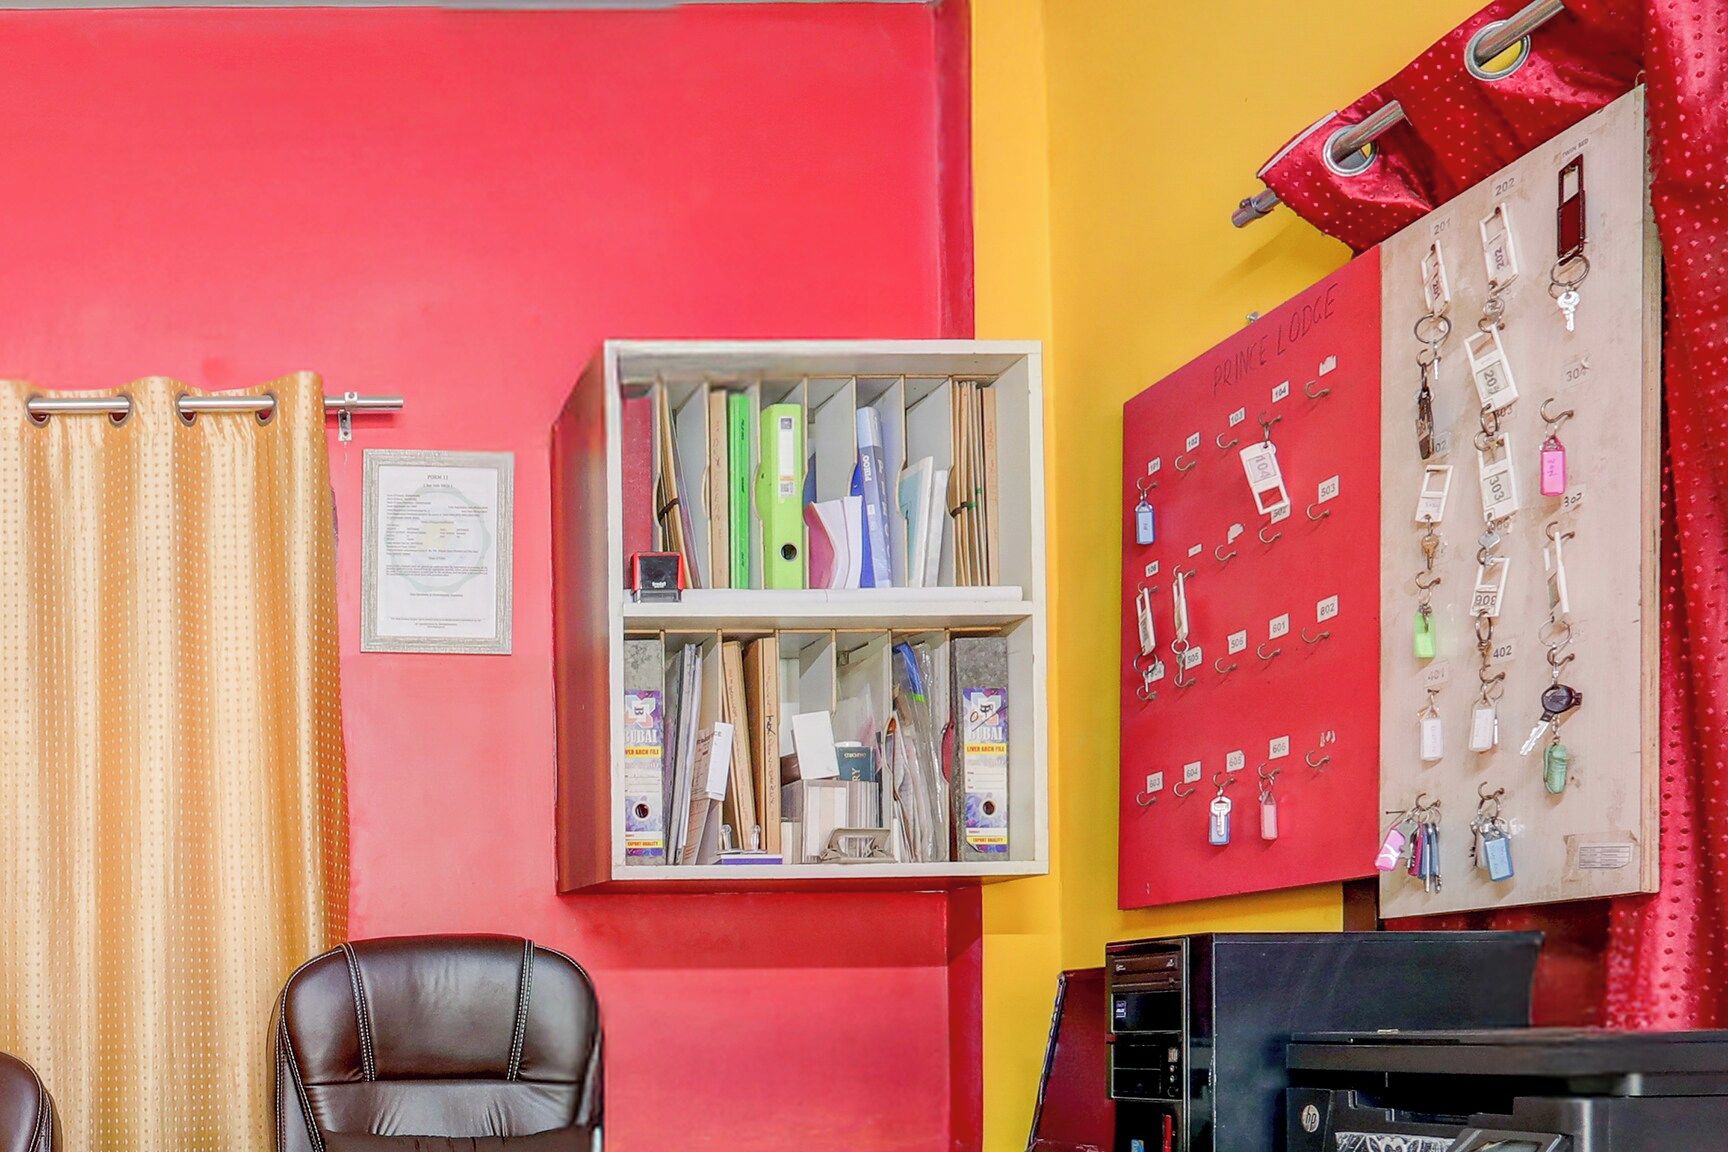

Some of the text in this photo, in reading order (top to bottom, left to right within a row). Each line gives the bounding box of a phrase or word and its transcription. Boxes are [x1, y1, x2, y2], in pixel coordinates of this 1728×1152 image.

[1495, 177, 1514, 196] 202
[1434, 217, 1451, 236] 201
[1213, 282, 1338, 396] PRINCE LODGE
[1274, 385, 1288, 399] 104
[1230, 411, 1244, 424] 103
[1187, 436, 1199, 448] 102
[1255, 454, 1272, 480] 104
[1320, 482, 1336, 497] 503
[1489, 475, 1505, 501] 303
[1493, 645, 1512, 659] 402
